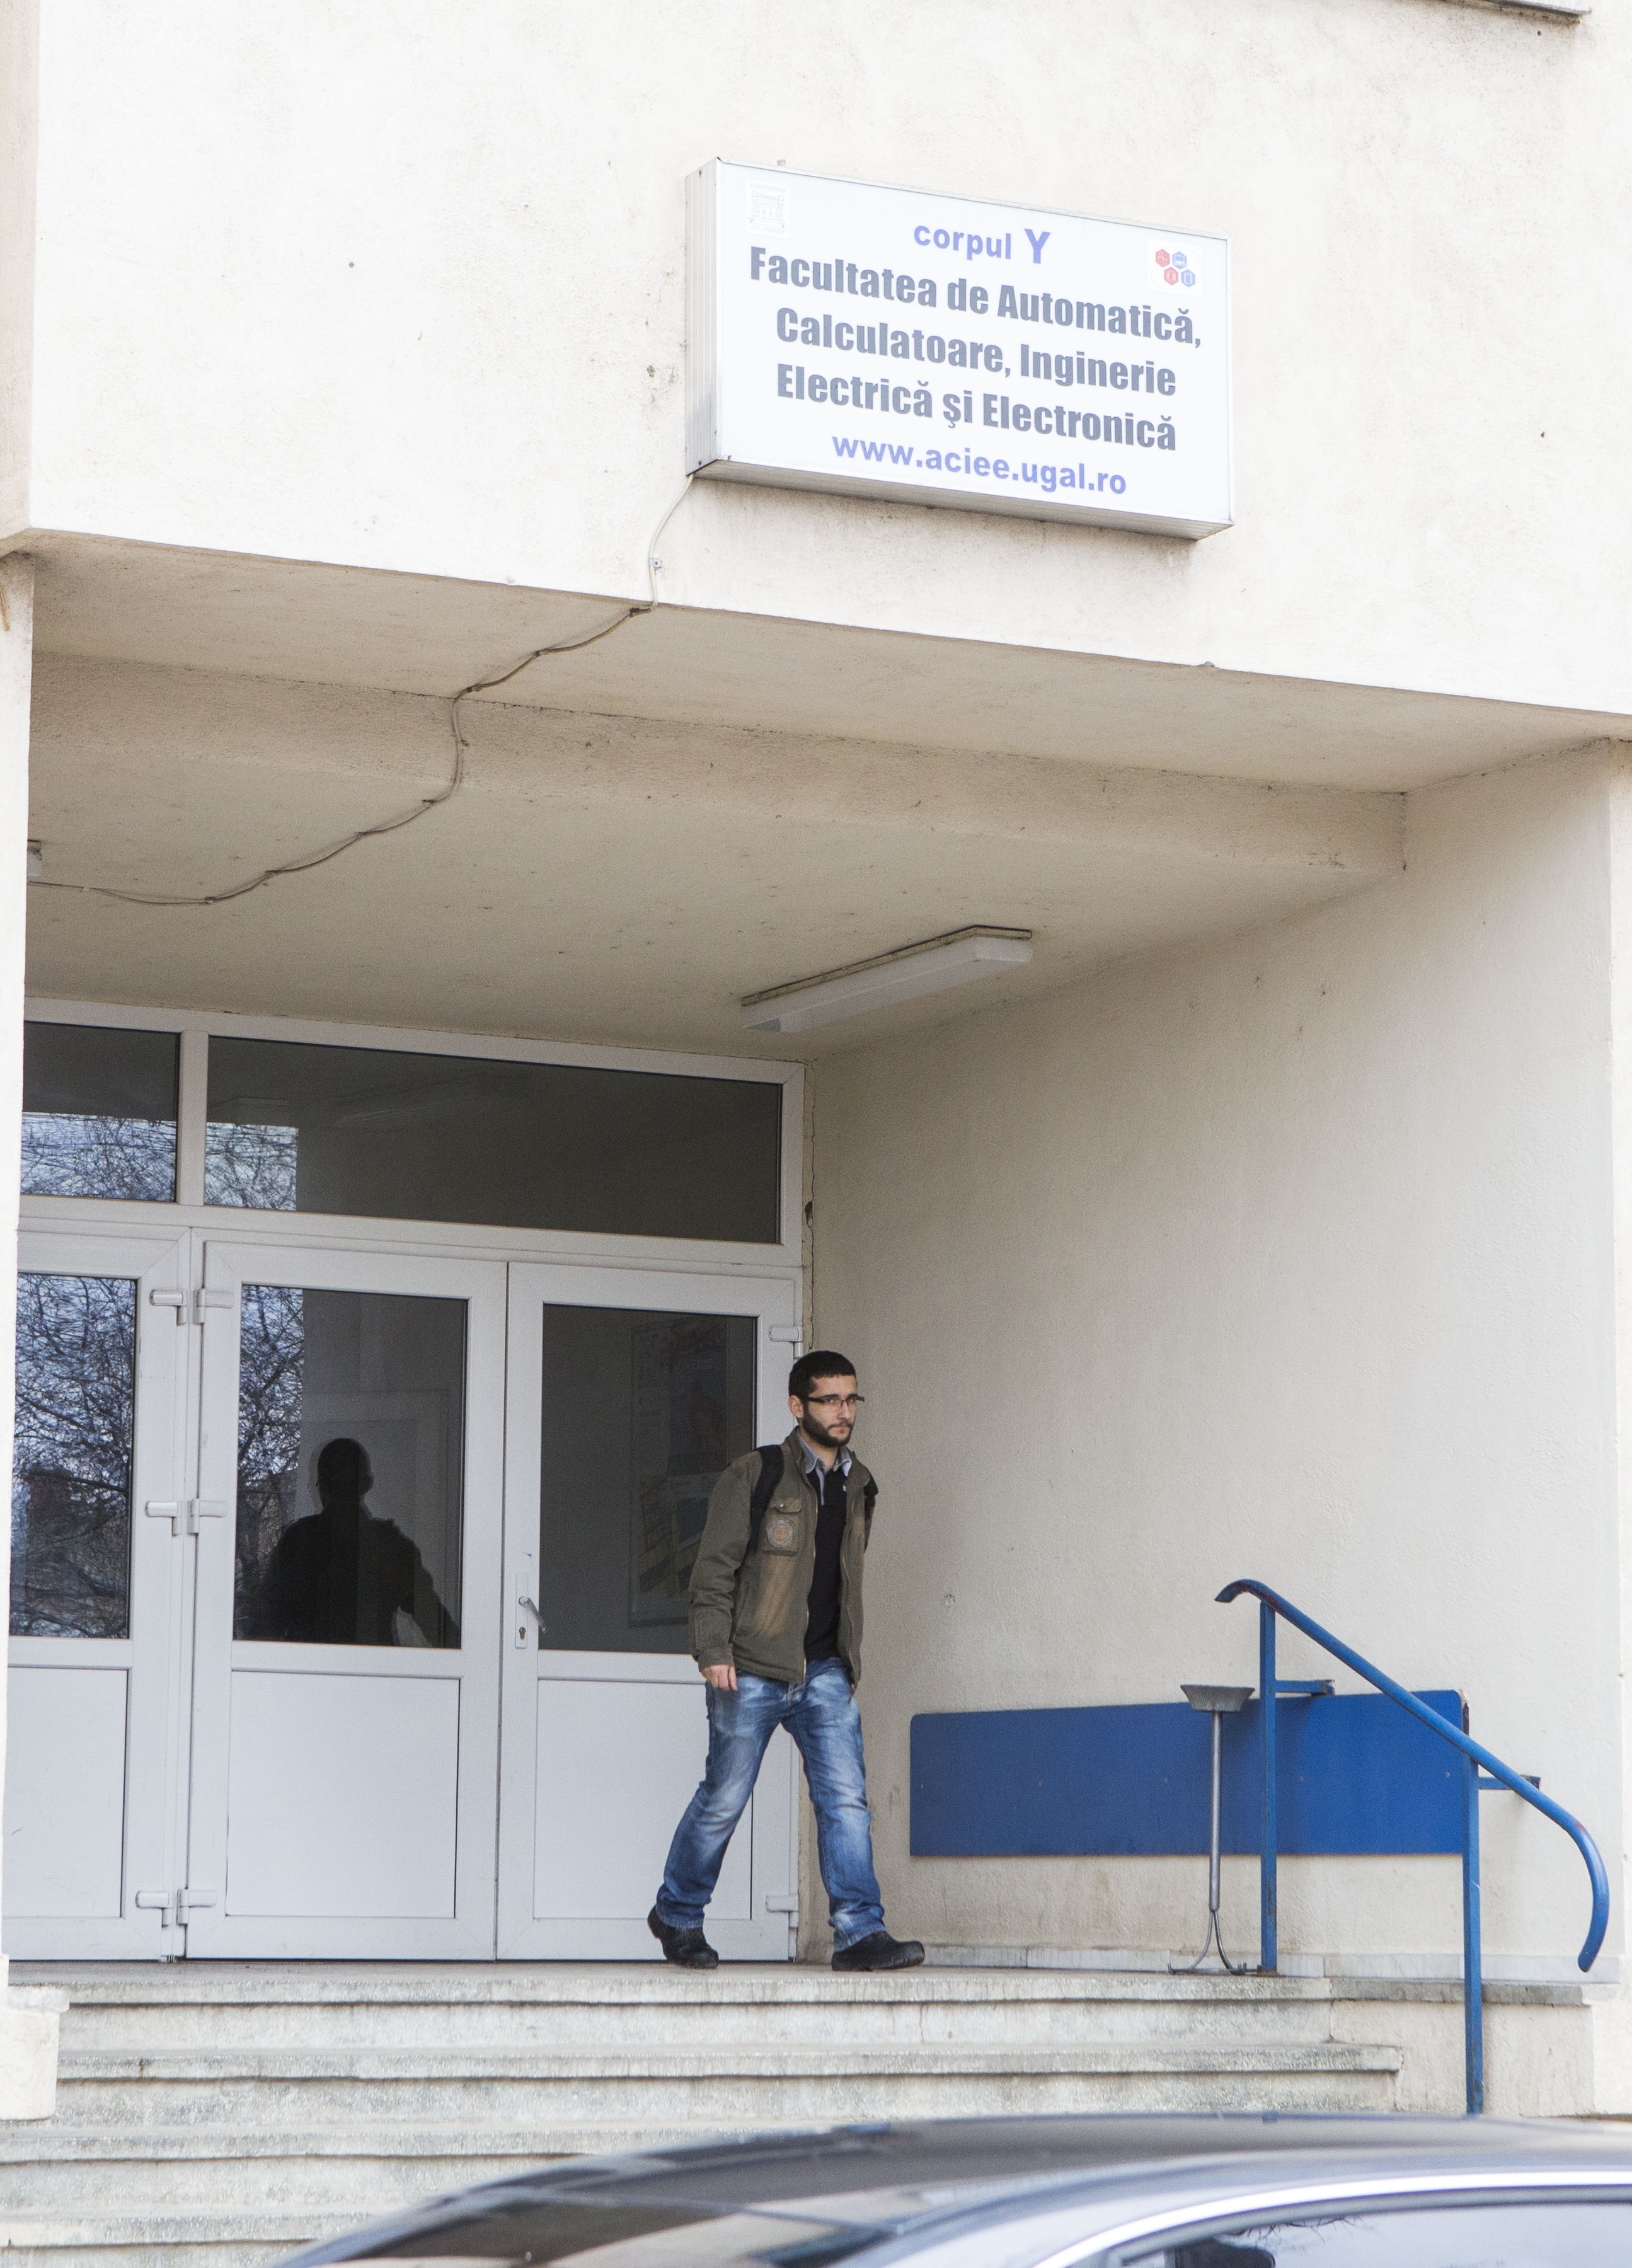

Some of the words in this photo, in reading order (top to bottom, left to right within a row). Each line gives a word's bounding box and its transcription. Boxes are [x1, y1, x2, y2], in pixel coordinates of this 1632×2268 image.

[914, 224, 1011, 260] corpul
[1024, 229, 1050, 264] Y
[751, 246, 936, 308] Facultatea
[948, 278, 988, 314] de
[997, 285, 1200, 348] Automatică,
[777, 308, 1010, 377] Calculatoare,
[1021, 344, 1176, 396] Inginerie
[778, 364, 932, 418] Electrică
[983, 393, 1176, 451] Electronică
[832, 435, 1126, 494] www.aciee.ugal.ro
